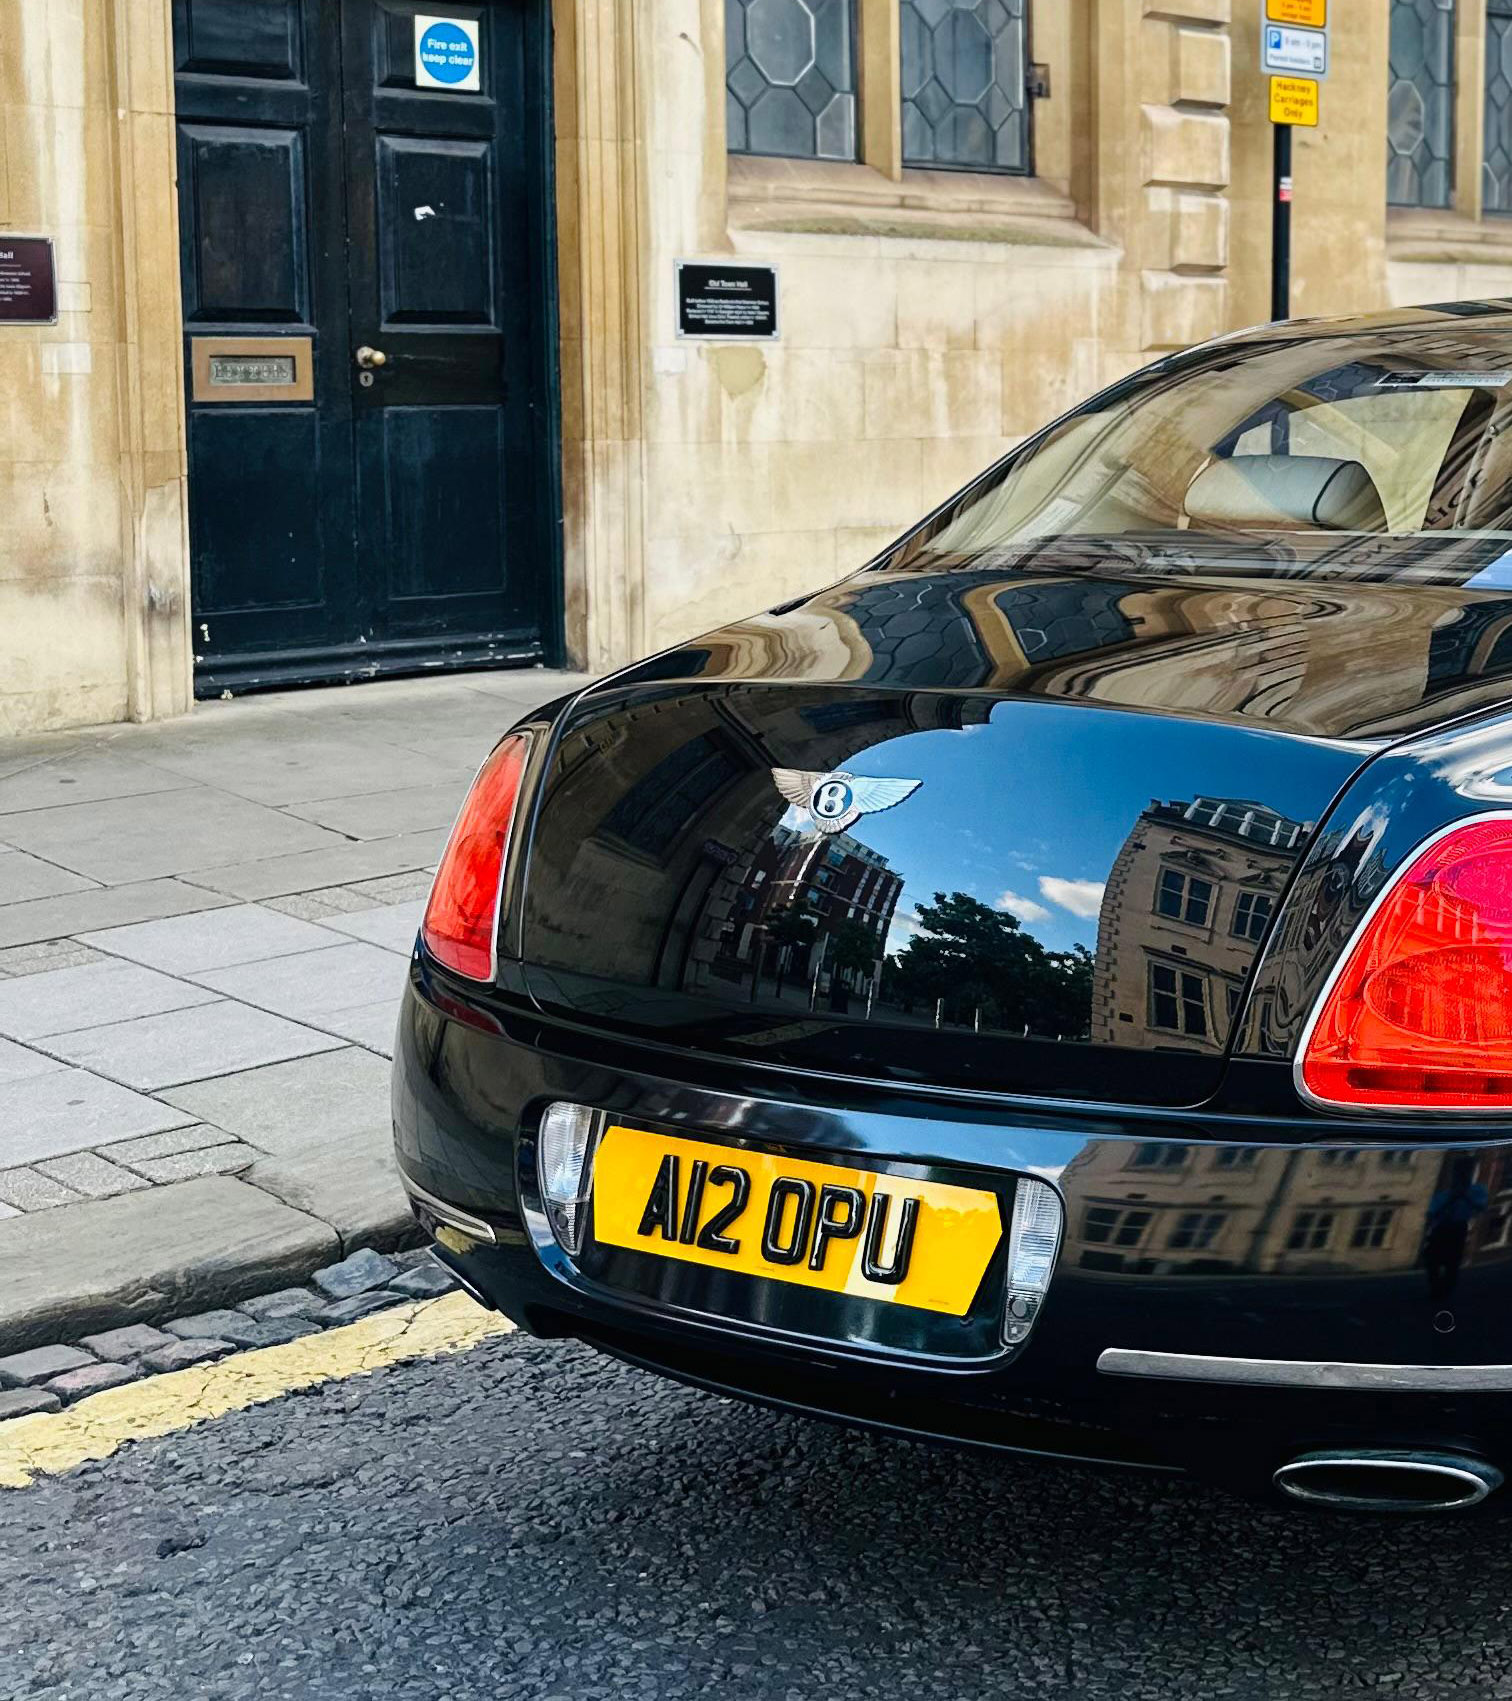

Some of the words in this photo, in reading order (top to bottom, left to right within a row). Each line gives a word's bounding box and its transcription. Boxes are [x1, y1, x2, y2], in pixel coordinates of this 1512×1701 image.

[427, 38, 447, 50] Fire
[449, 42, 468, 52] exit
[422, 52, 447, 65] keep
[448, 54, 474, 66] clear
[1275, 80, 1311, 95] Hackney
[1273, 93, 1314, 107] Carriages
[1284, 107, 1303, 120] Only
[708, 280, 720, 288] Old
[721, 280, 736, 288] Town
[736, 281, 748, 289] Hall
[817, 782, 847, 817] B
[637, 1154, 751, 1255] A12
[761, 1176, 921, 1285] OPU
